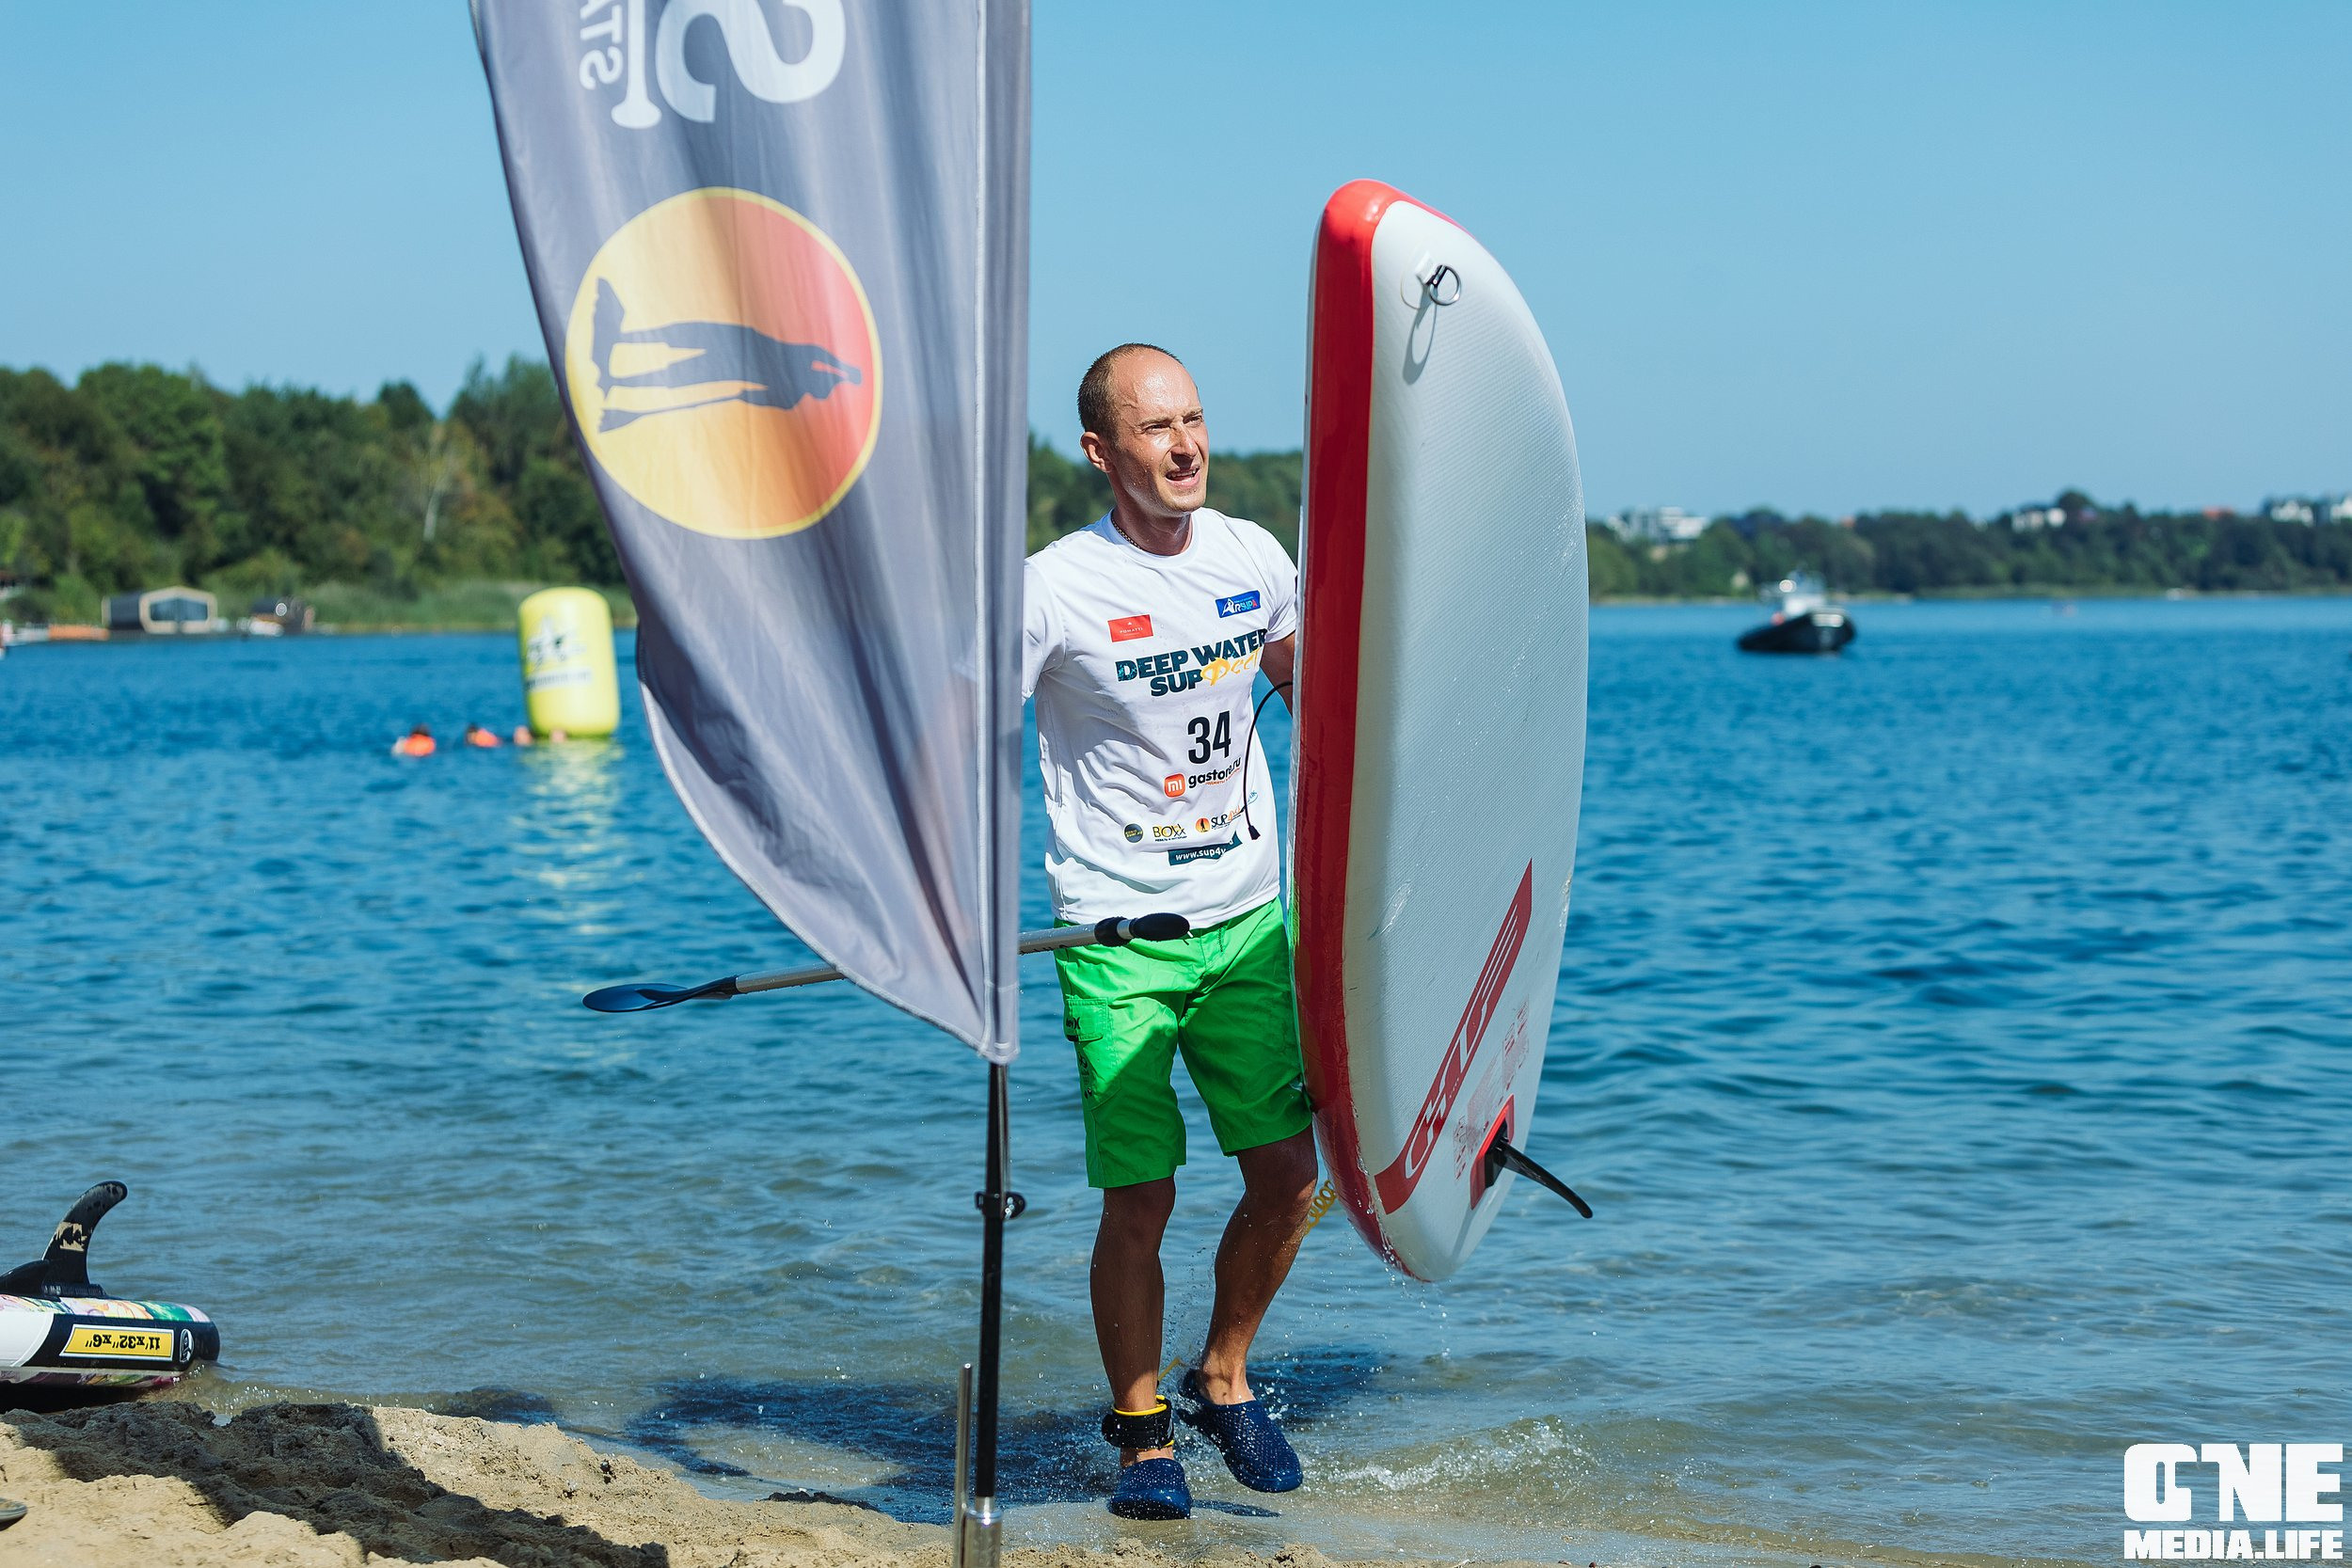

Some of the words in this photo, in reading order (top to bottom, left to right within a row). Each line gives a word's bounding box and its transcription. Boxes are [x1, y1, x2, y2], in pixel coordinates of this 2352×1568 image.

[1115, 649, 1189, 682] DEEP
[1190, 628, 1268, 667] WATER
[1150, 669, 1203, 697] SUP
[1187, 710, 1232, 765] 34
